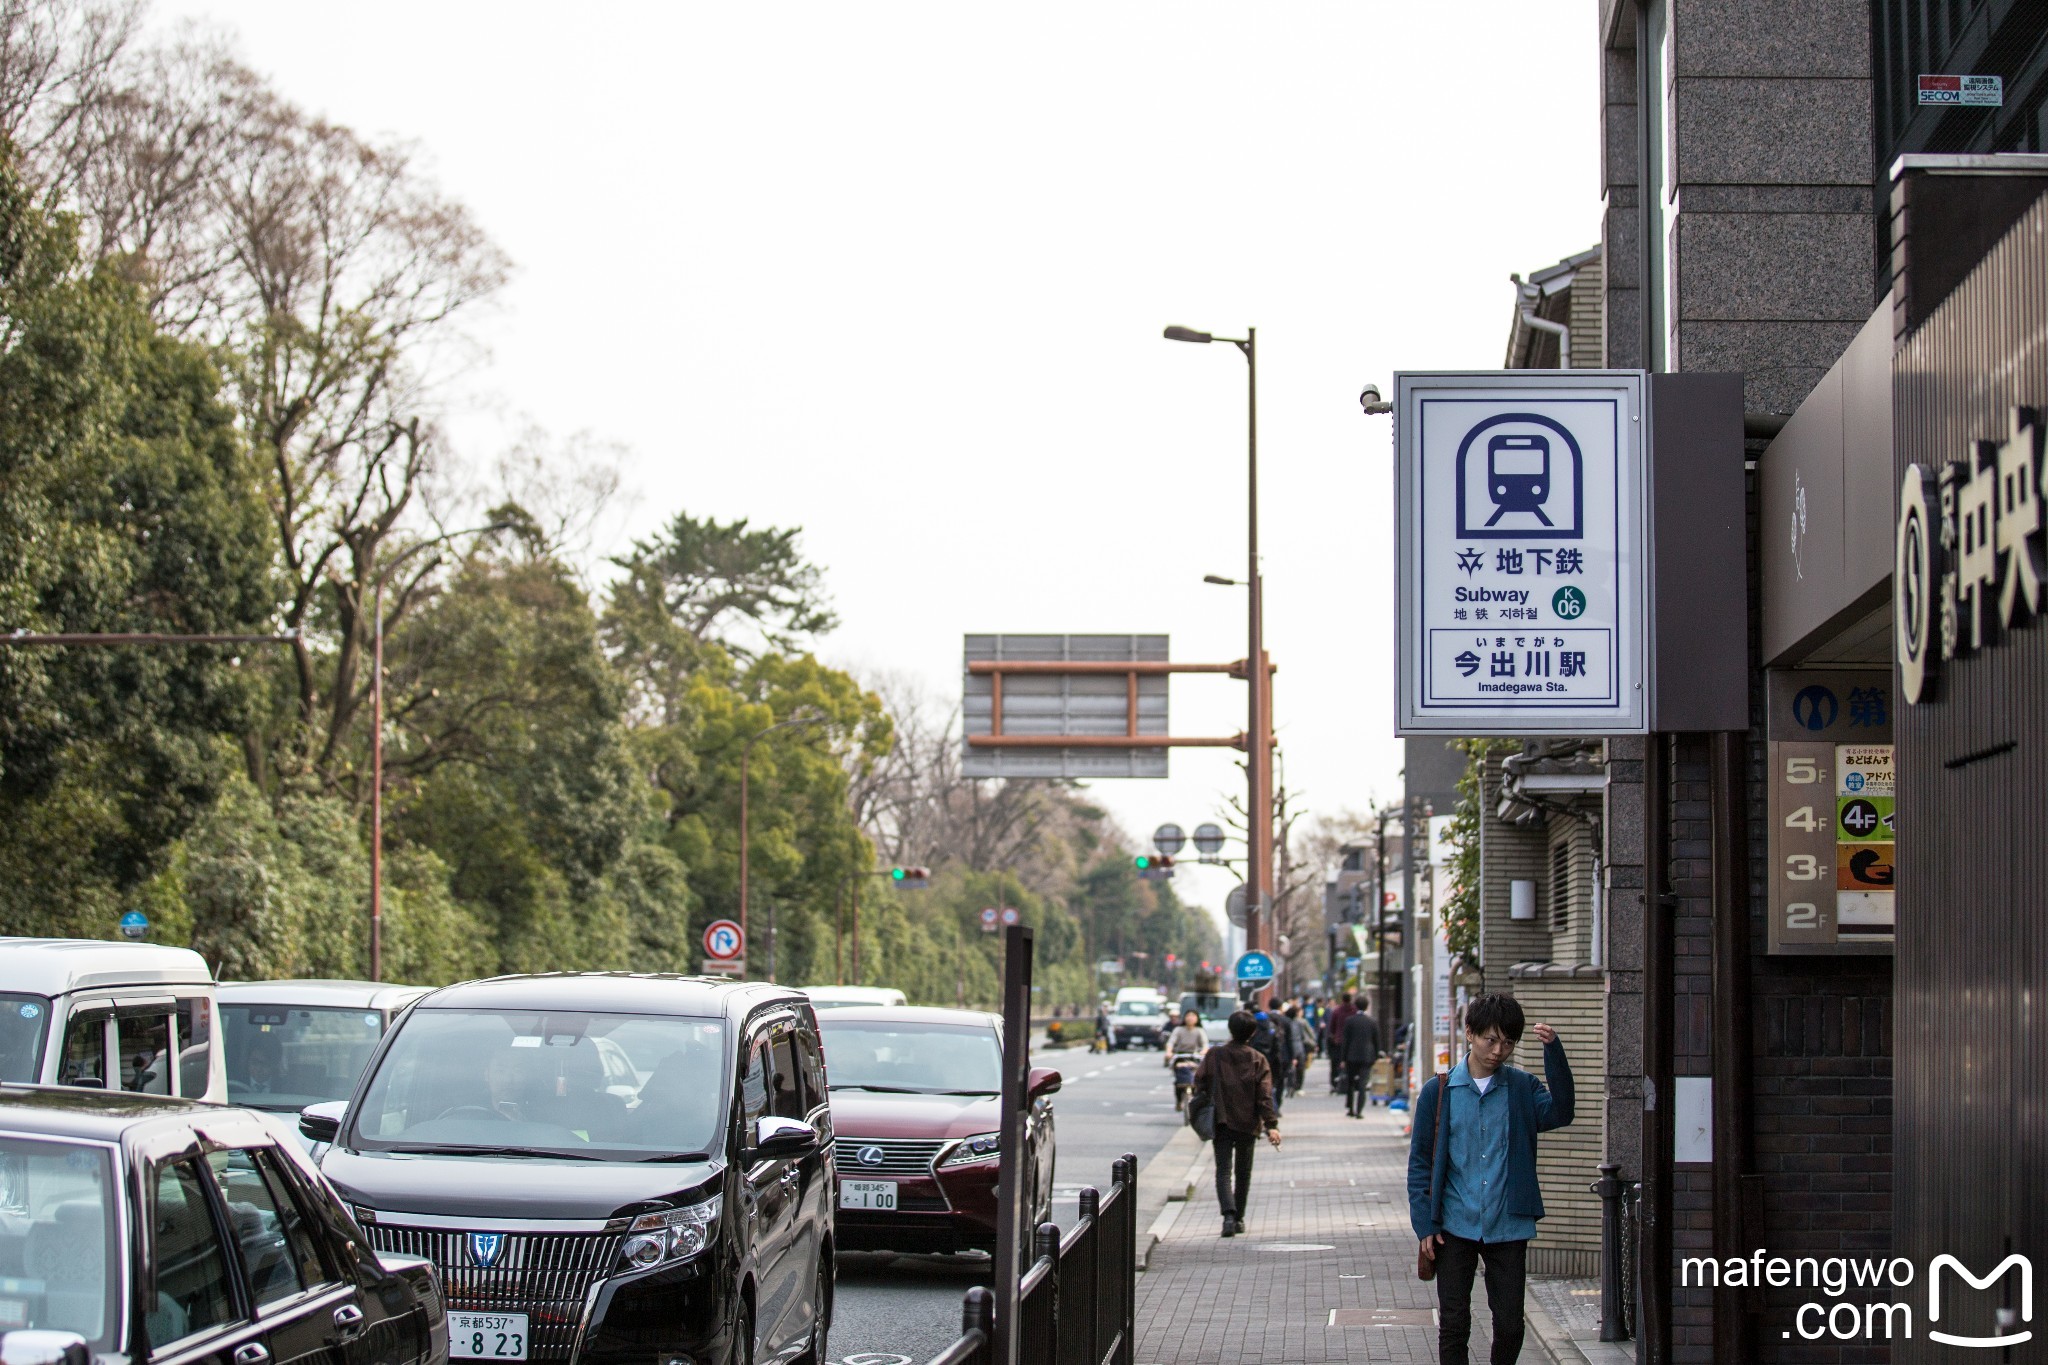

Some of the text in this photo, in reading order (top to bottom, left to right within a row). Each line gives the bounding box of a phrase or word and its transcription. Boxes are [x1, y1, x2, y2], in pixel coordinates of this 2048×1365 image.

[1921, 91, 1960, 101] SECOM
[1496, 547, 1584, 576] 地下鉄
[1455, 586, 1530, 606] Subway
[1564, 588, 1573, 599] K
[1500, 608, 1538, 620] 지하철
[1557, 599, 1581, 616] 06
[1476, 636, 1565, 648] いまでがわ
[1455, 651, 1586, 678] 今出川駅
[1478, 682, 1568, 694] Imadegawa Sta.
[1846, 755, 1890, 765] あどばんす
[1786, 757, 1828, 784] 5F
[1785, 806, 1828, 833] 4F
[1844, 805, 1876, 829] 4F
[1786, 854, 1828, 881] 3F
[1786, 902, 1828, 929] 2F
[459, 1316, 508, 1330] 京都537
